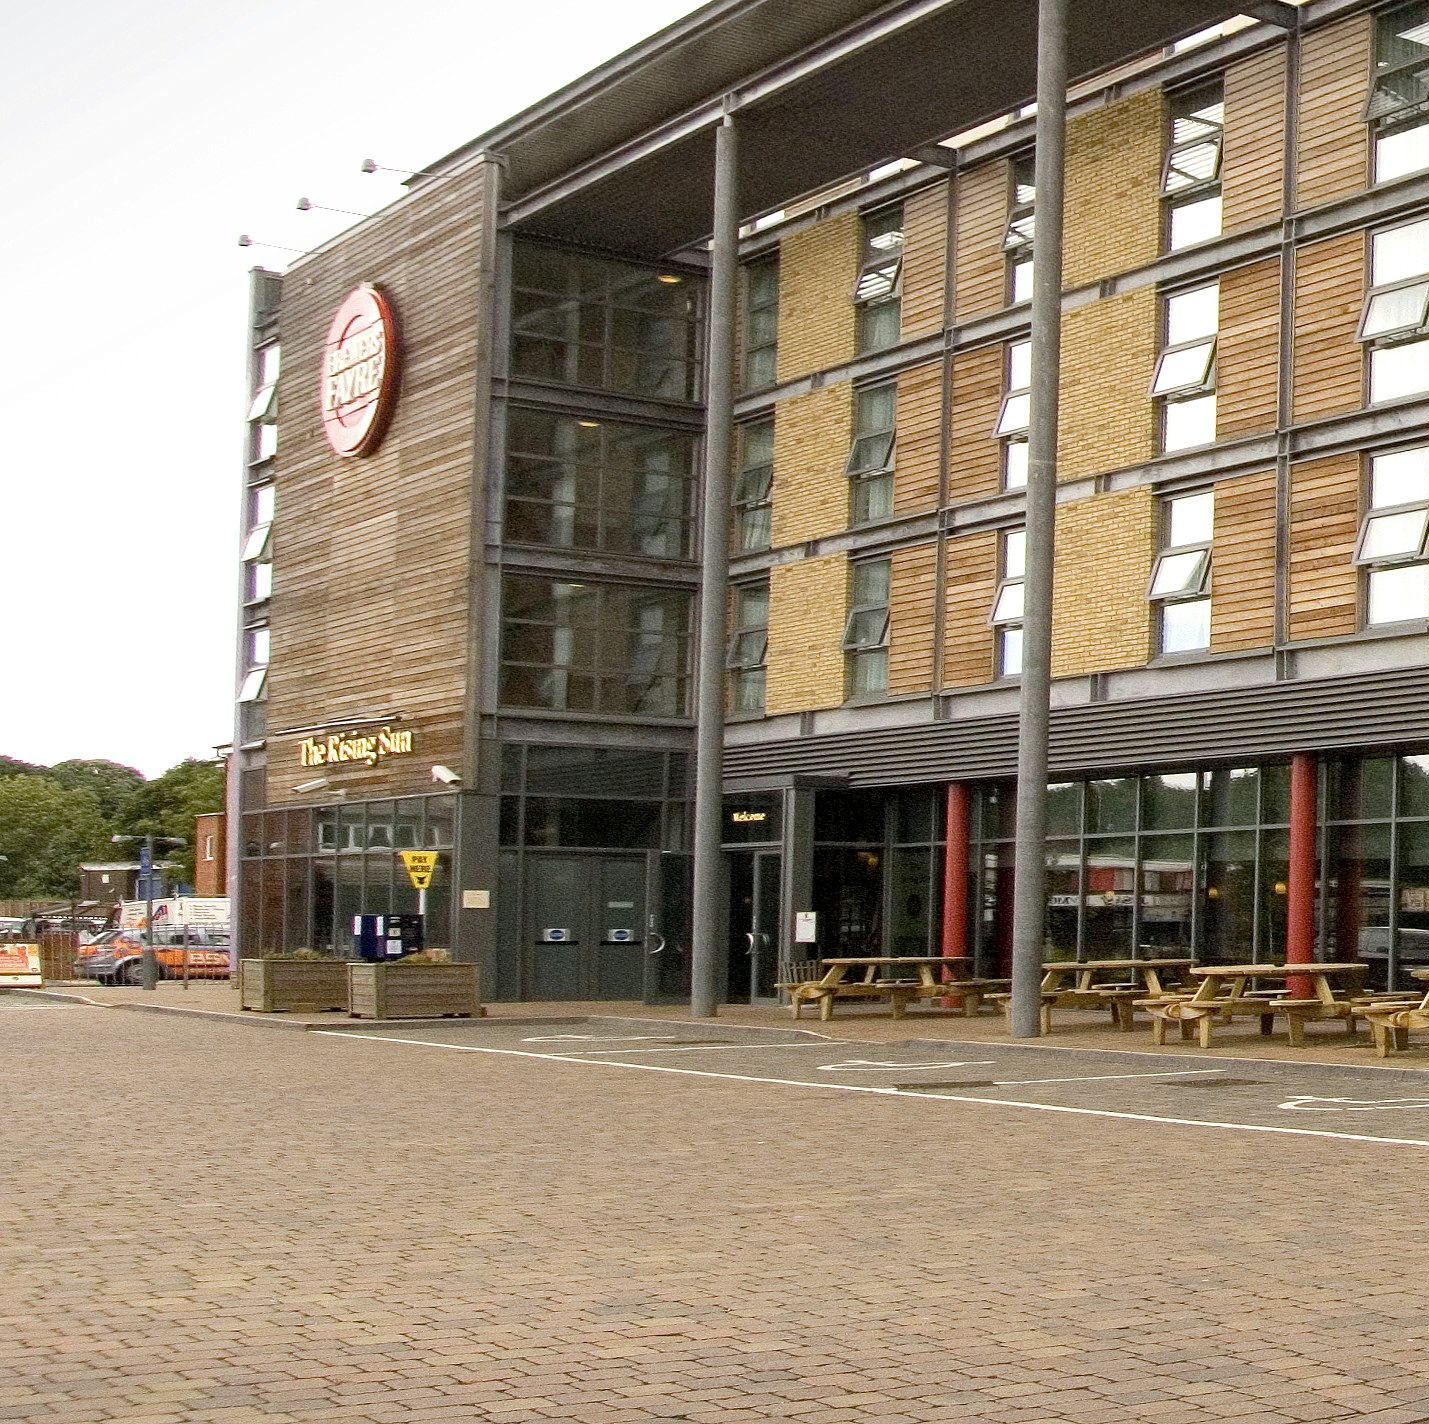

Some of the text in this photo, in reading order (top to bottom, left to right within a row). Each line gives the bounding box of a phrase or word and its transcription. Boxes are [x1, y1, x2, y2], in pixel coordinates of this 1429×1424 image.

[298, 726, 413, 767] The Rising Sun
